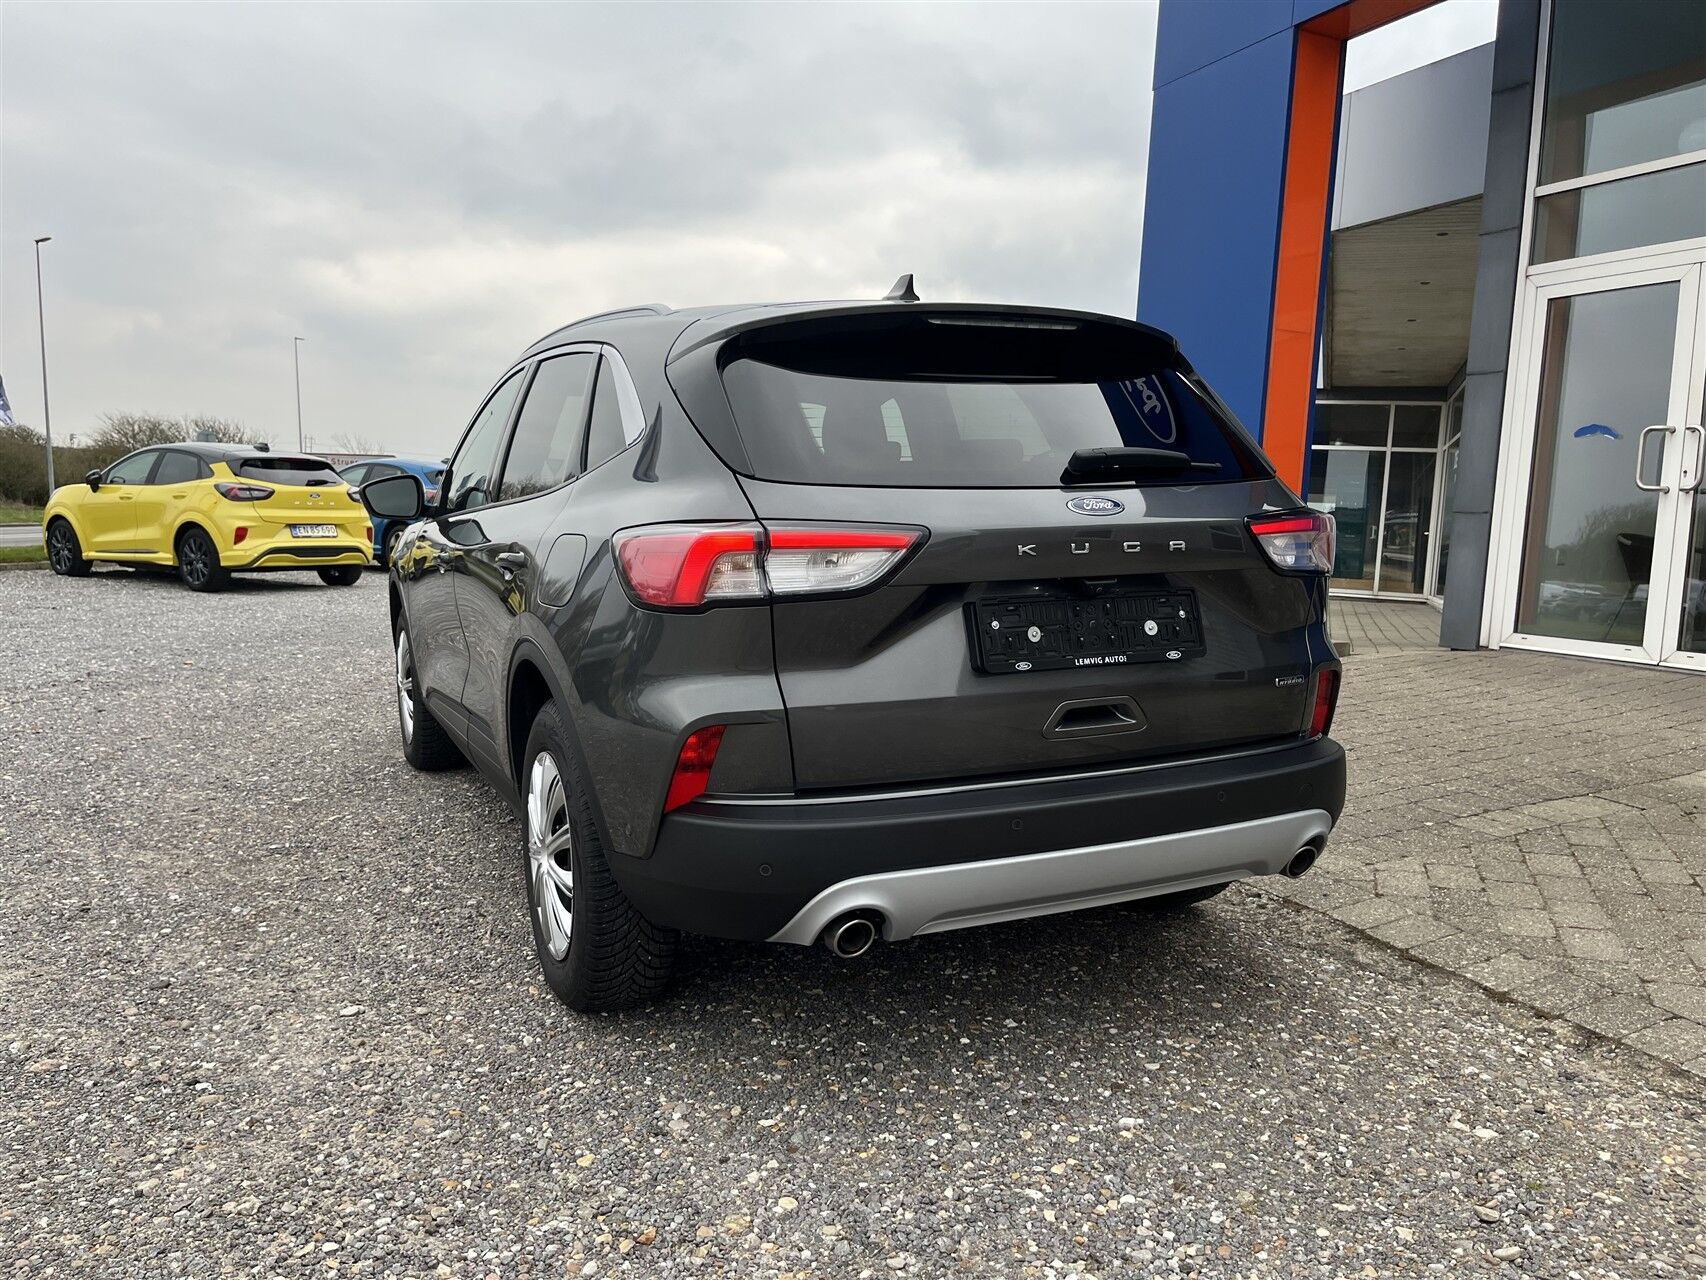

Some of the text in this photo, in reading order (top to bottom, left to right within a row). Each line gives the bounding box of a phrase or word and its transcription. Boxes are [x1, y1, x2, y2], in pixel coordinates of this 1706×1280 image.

[1083, 499, 1114, 510] Ford
[298, 526, 309, 534] EN
[1017, 540, 1186, 556] KUGA
[1075, 656, 1103, 666] LEMVIG
